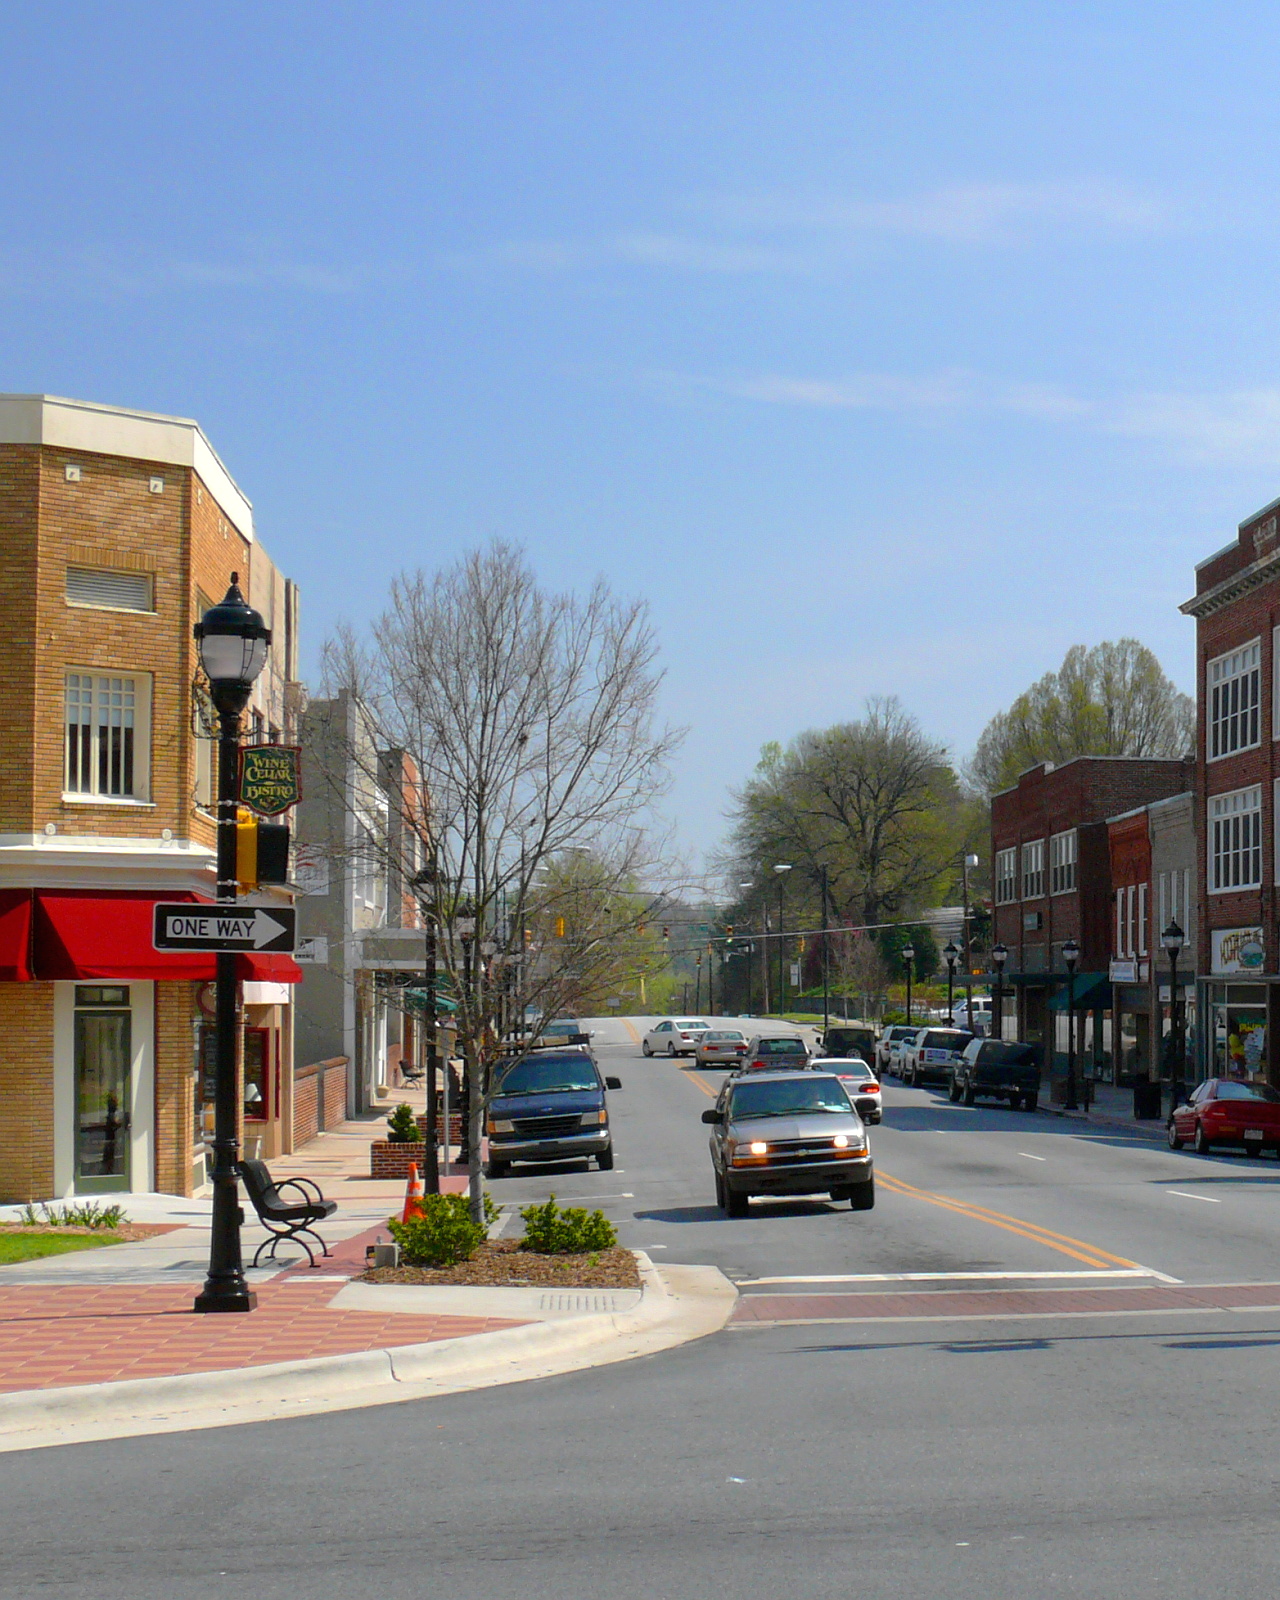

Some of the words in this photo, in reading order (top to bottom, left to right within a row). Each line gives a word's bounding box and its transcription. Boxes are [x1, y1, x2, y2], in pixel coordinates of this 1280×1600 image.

[252, 757, 290, 769] WINE
[245, 767, 293, 782] CELLAR
[246, 785, 294, 799] BISTRO
[171, 918, 209, 936] ONE
[216, 919, 255, 937] WAY
